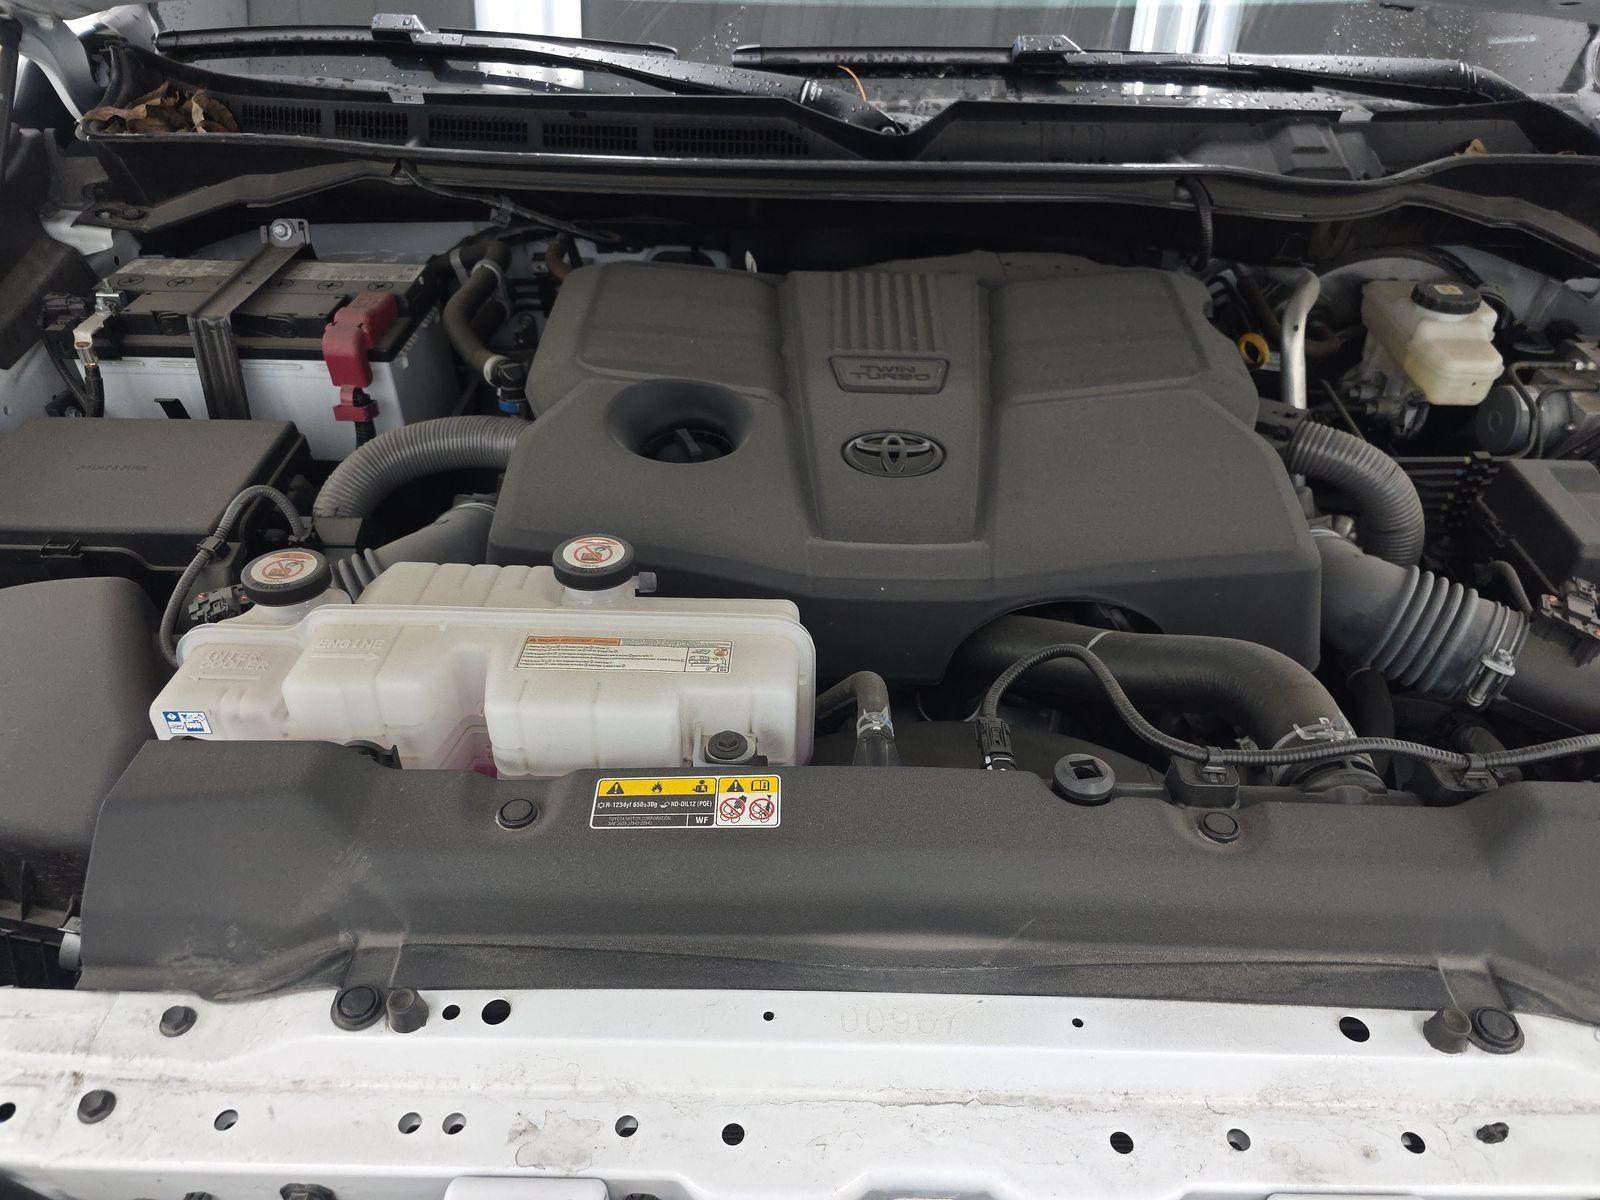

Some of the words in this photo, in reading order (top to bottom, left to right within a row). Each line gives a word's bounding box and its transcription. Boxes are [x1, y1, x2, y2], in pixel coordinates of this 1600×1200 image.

[859, 365, 916, 373] TWIN
[849, 372, 930, 381] TURBO
[317, 638, 385, 650] ENGINE
[695, 816, 709, 824] WF
